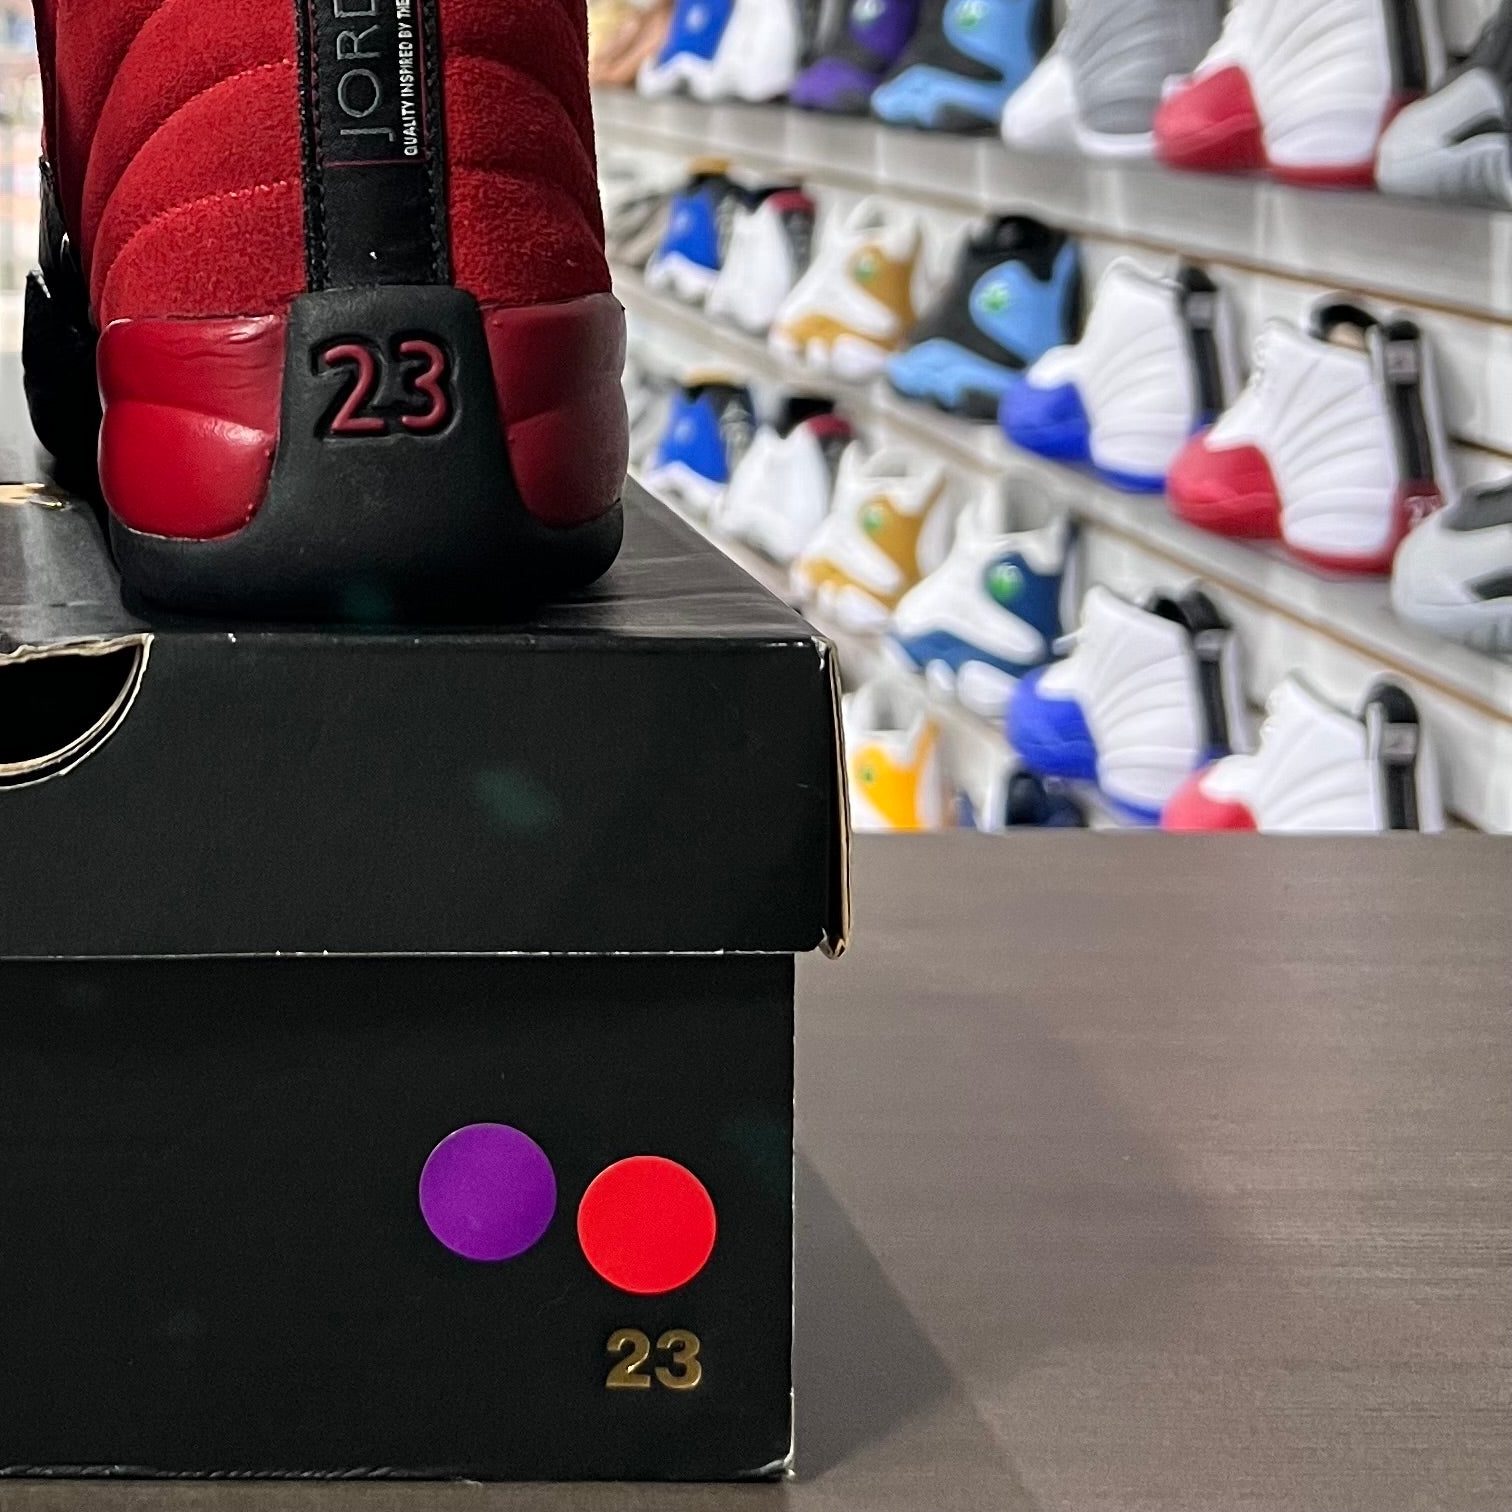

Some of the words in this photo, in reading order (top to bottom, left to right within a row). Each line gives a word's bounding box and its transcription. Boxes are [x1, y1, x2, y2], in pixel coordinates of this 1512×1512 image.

[397, 0, 411, 19] THE
[399, 22, 413, 39] BY
[400, 41, 416, 97] INSPIRED
[403, 100, 419, 156] QUALITY
[319, 337, 453, 439] 23
[605, 1328, 702, 1390] 23
